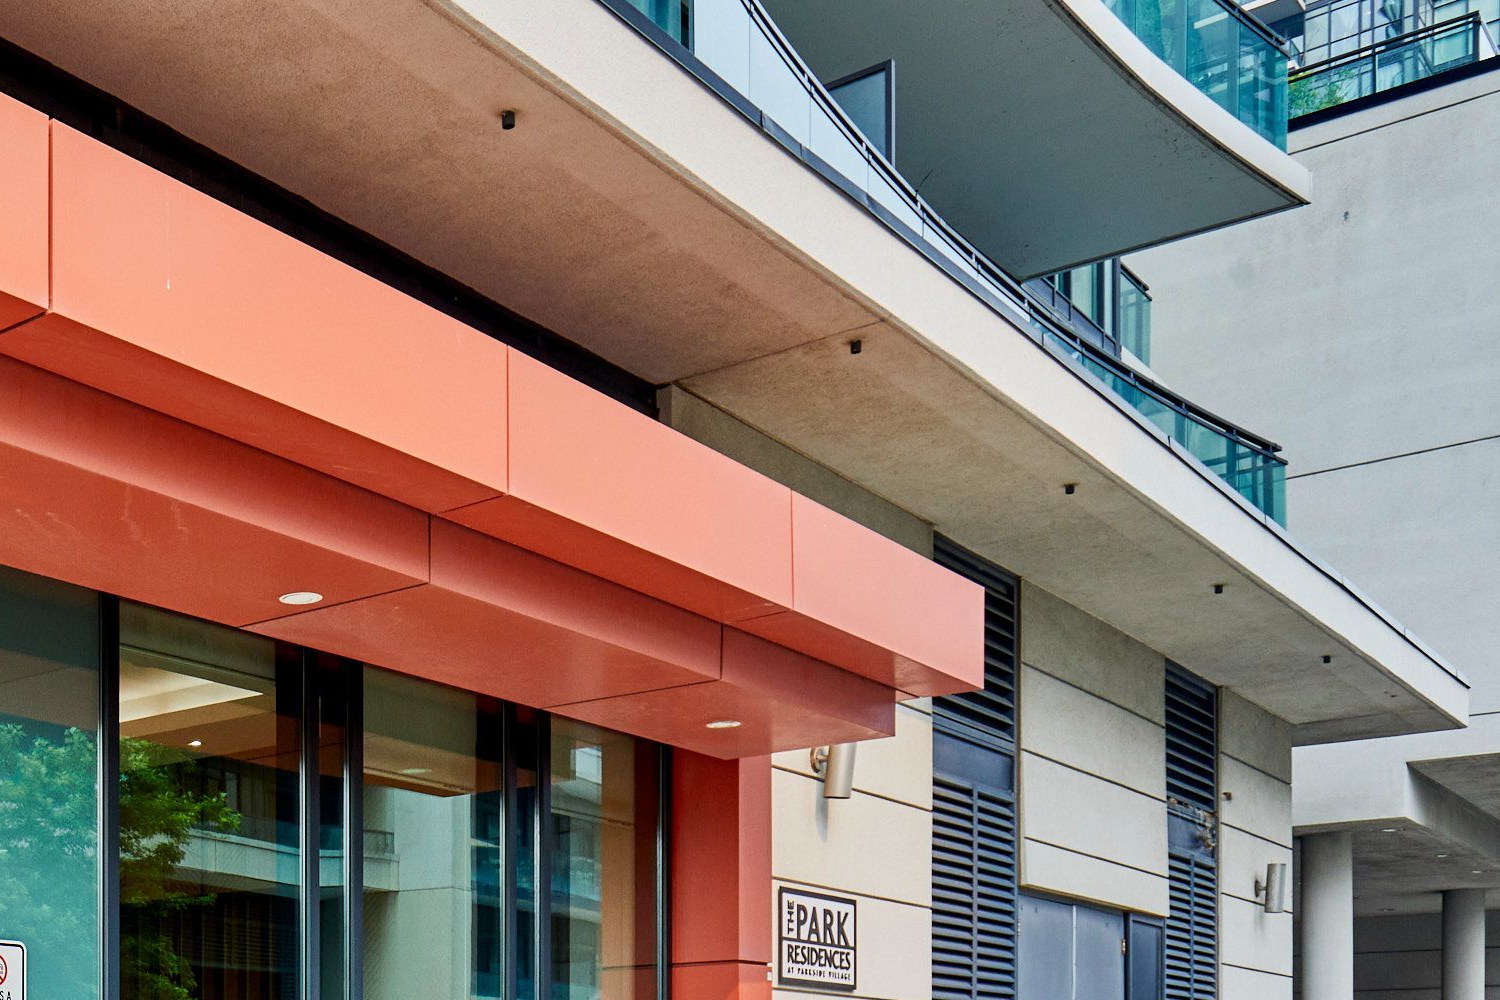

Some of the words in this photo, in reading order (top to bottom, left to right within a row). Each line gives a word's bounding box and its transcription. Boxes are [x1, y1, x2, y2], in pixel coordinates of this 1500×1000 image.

[787, 900, 795, 935] THE
[796, 903, 850, 946] PARK
[787, 944, 851, 970] RESIDENCES
[797, 968, 826, 978] PARKSIDE
[829, 971, 851, 981] VILLAGE
